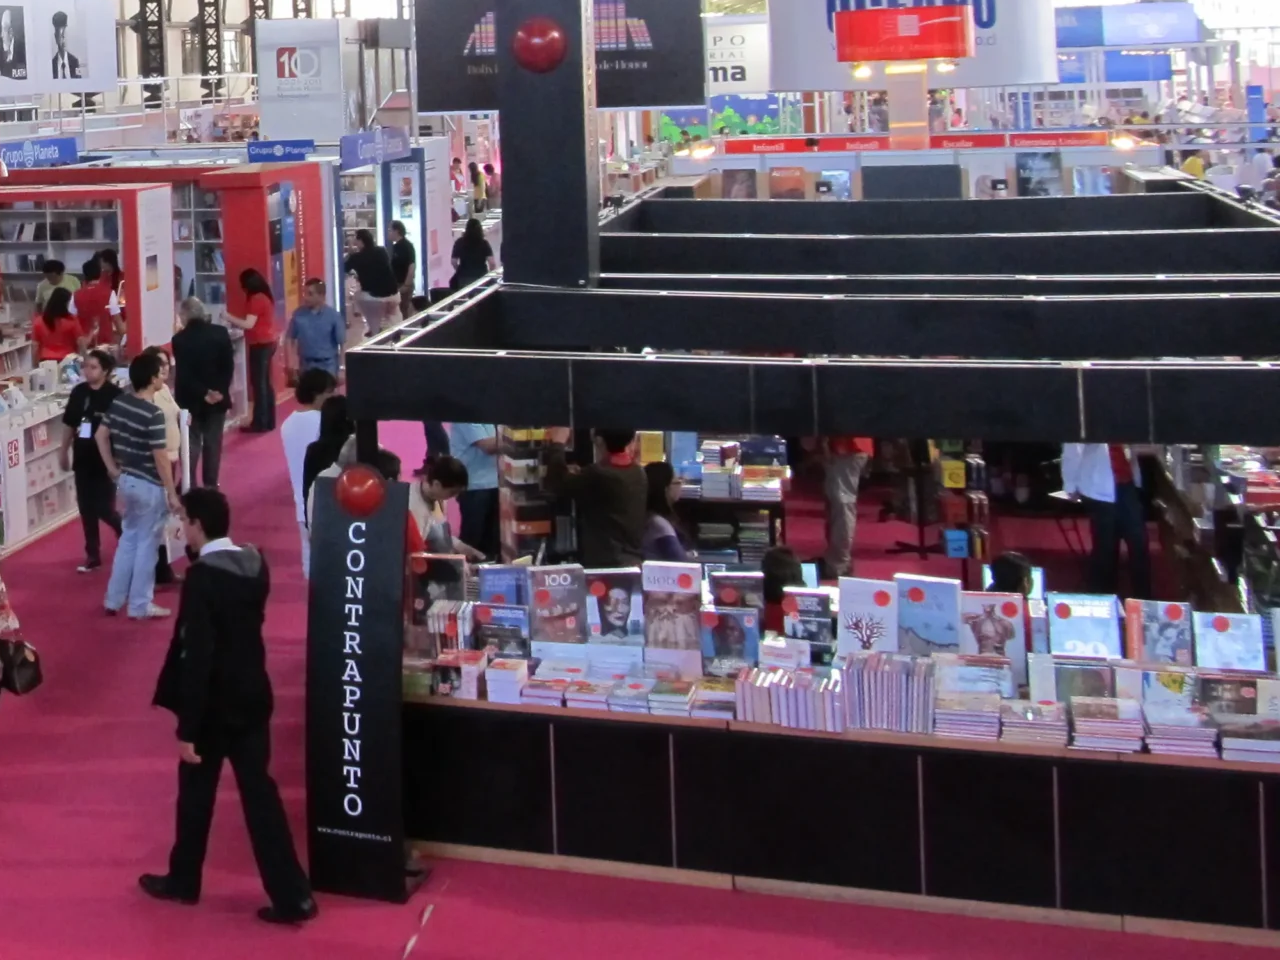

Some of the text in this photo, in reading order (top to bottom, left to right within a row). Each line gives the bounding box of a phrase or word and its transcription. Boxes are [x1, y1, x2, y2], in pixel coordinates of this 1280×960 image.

[0, 144, 59, 168] Grupo Planeta
[249, 146, 314, 156] Grupo Planeta
[545, 573, 571, 586] 100
[341, 521, 367, 817] CONTRAPUNTO
